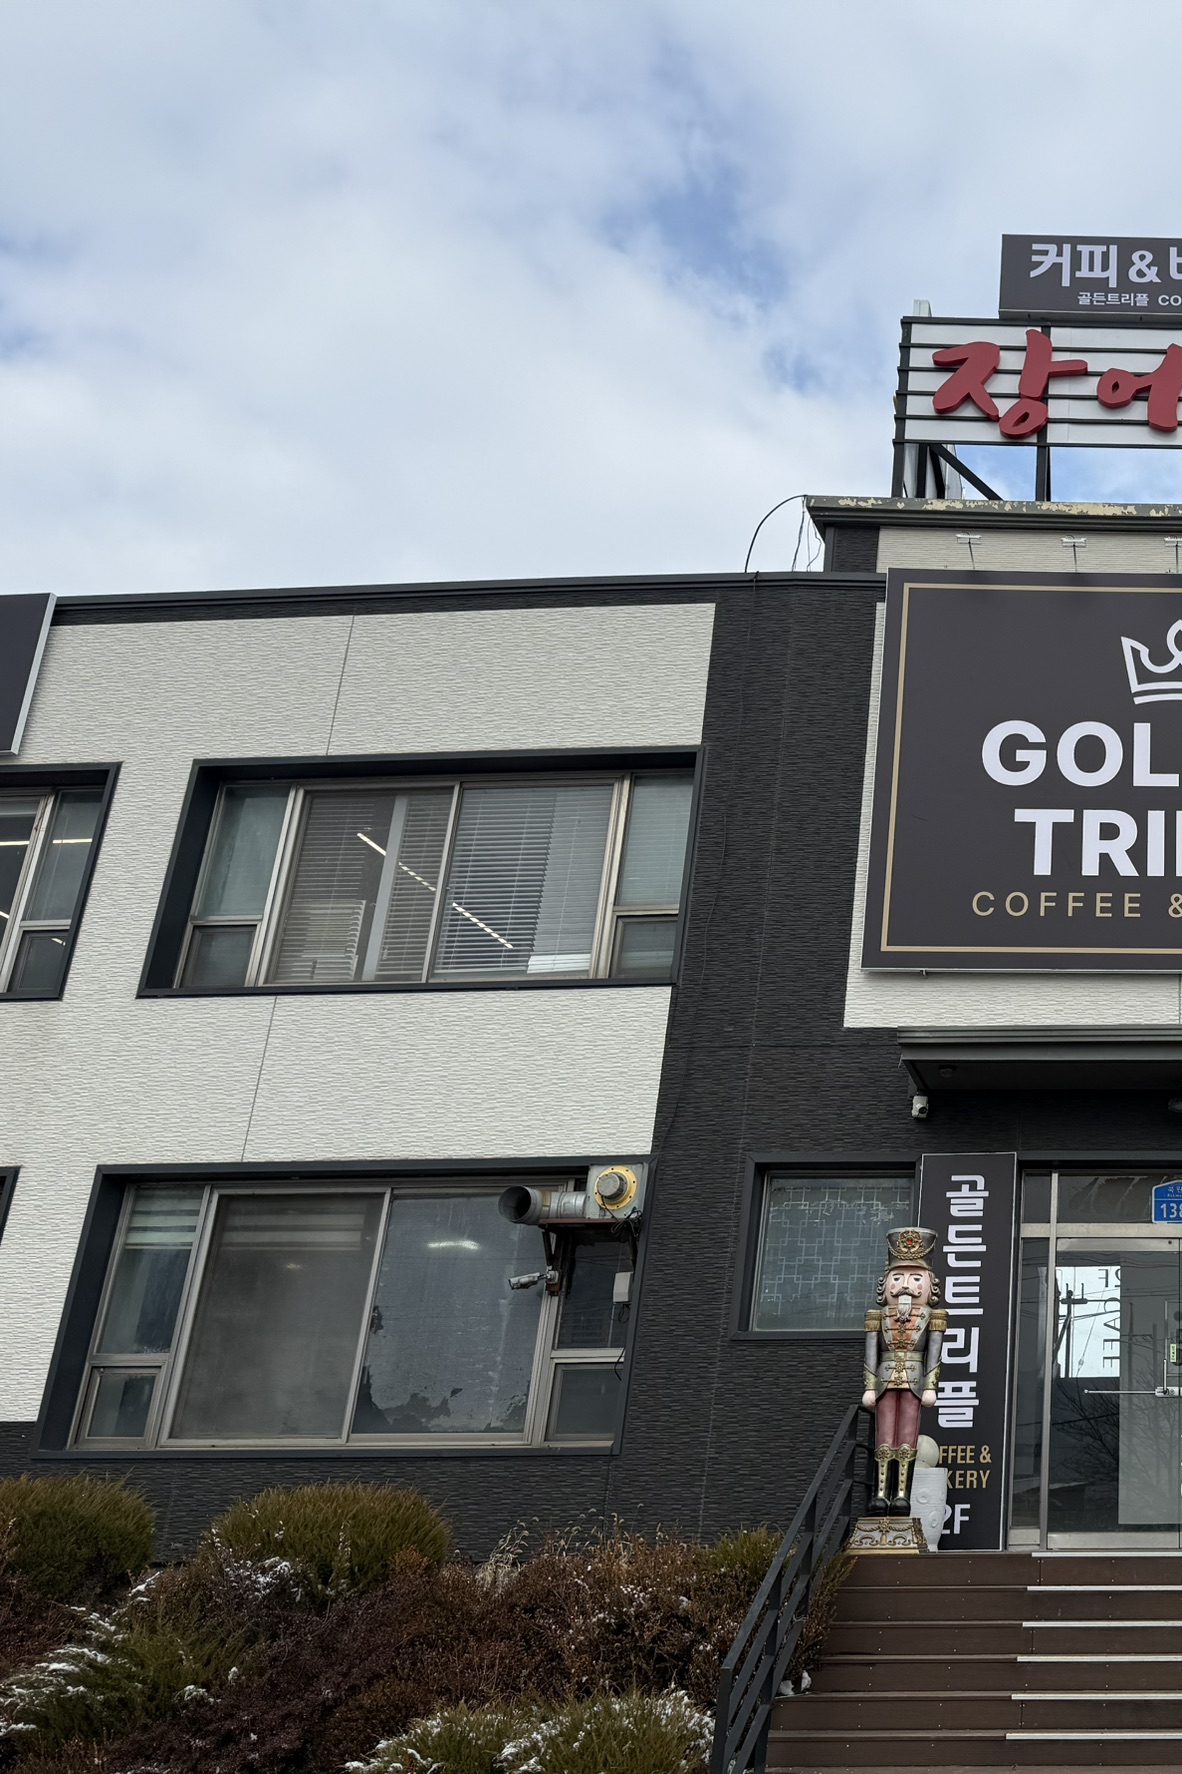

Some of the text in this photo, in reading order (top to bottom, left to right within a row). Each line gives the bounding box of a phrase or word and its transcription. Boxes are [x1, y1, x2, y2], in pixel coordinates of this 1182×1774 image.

[1078, 292, 1149, 307] 골든트리플
[971, 891, 1142, 919] COFFEE
[934, 1174, 990, 1428] 골든트리플
[938, 1445, 992, 1464] FFEE &
[946, 1470, 990, 1488] KERY
